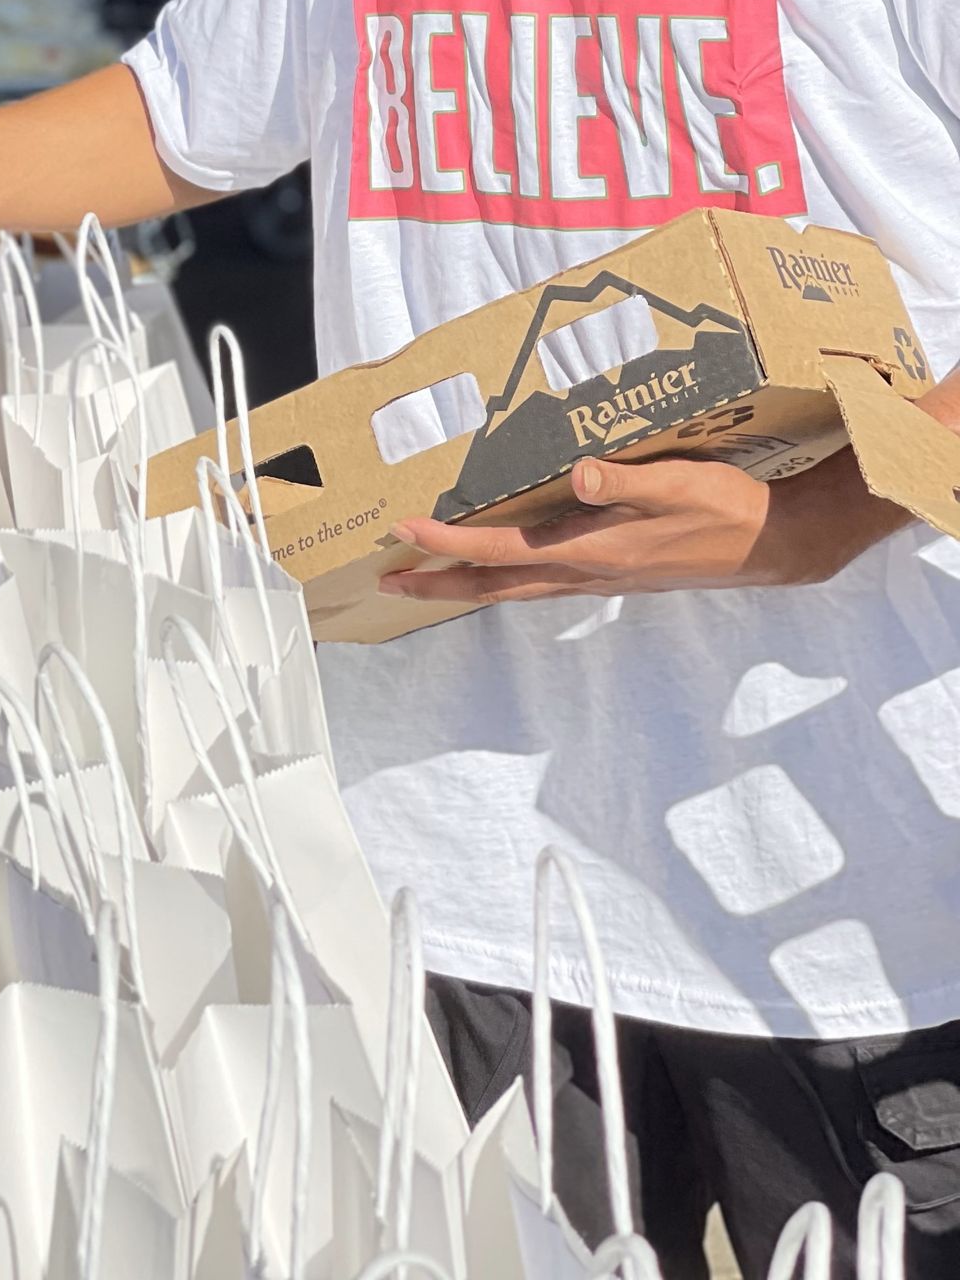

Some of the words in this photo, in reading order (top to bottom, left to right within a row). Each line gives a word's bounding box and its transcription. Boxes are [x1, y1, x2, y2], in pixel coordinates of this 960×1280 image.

[365, 12, 784, 200] BELIEVE.
[766, 246, 856, 293] Rainier
[566, 361, 696, 447] Rainier
[650, 386, 700, 413] FRUIT
[298, 535, 315, 552] to
[317, 521, 343, 543] the
